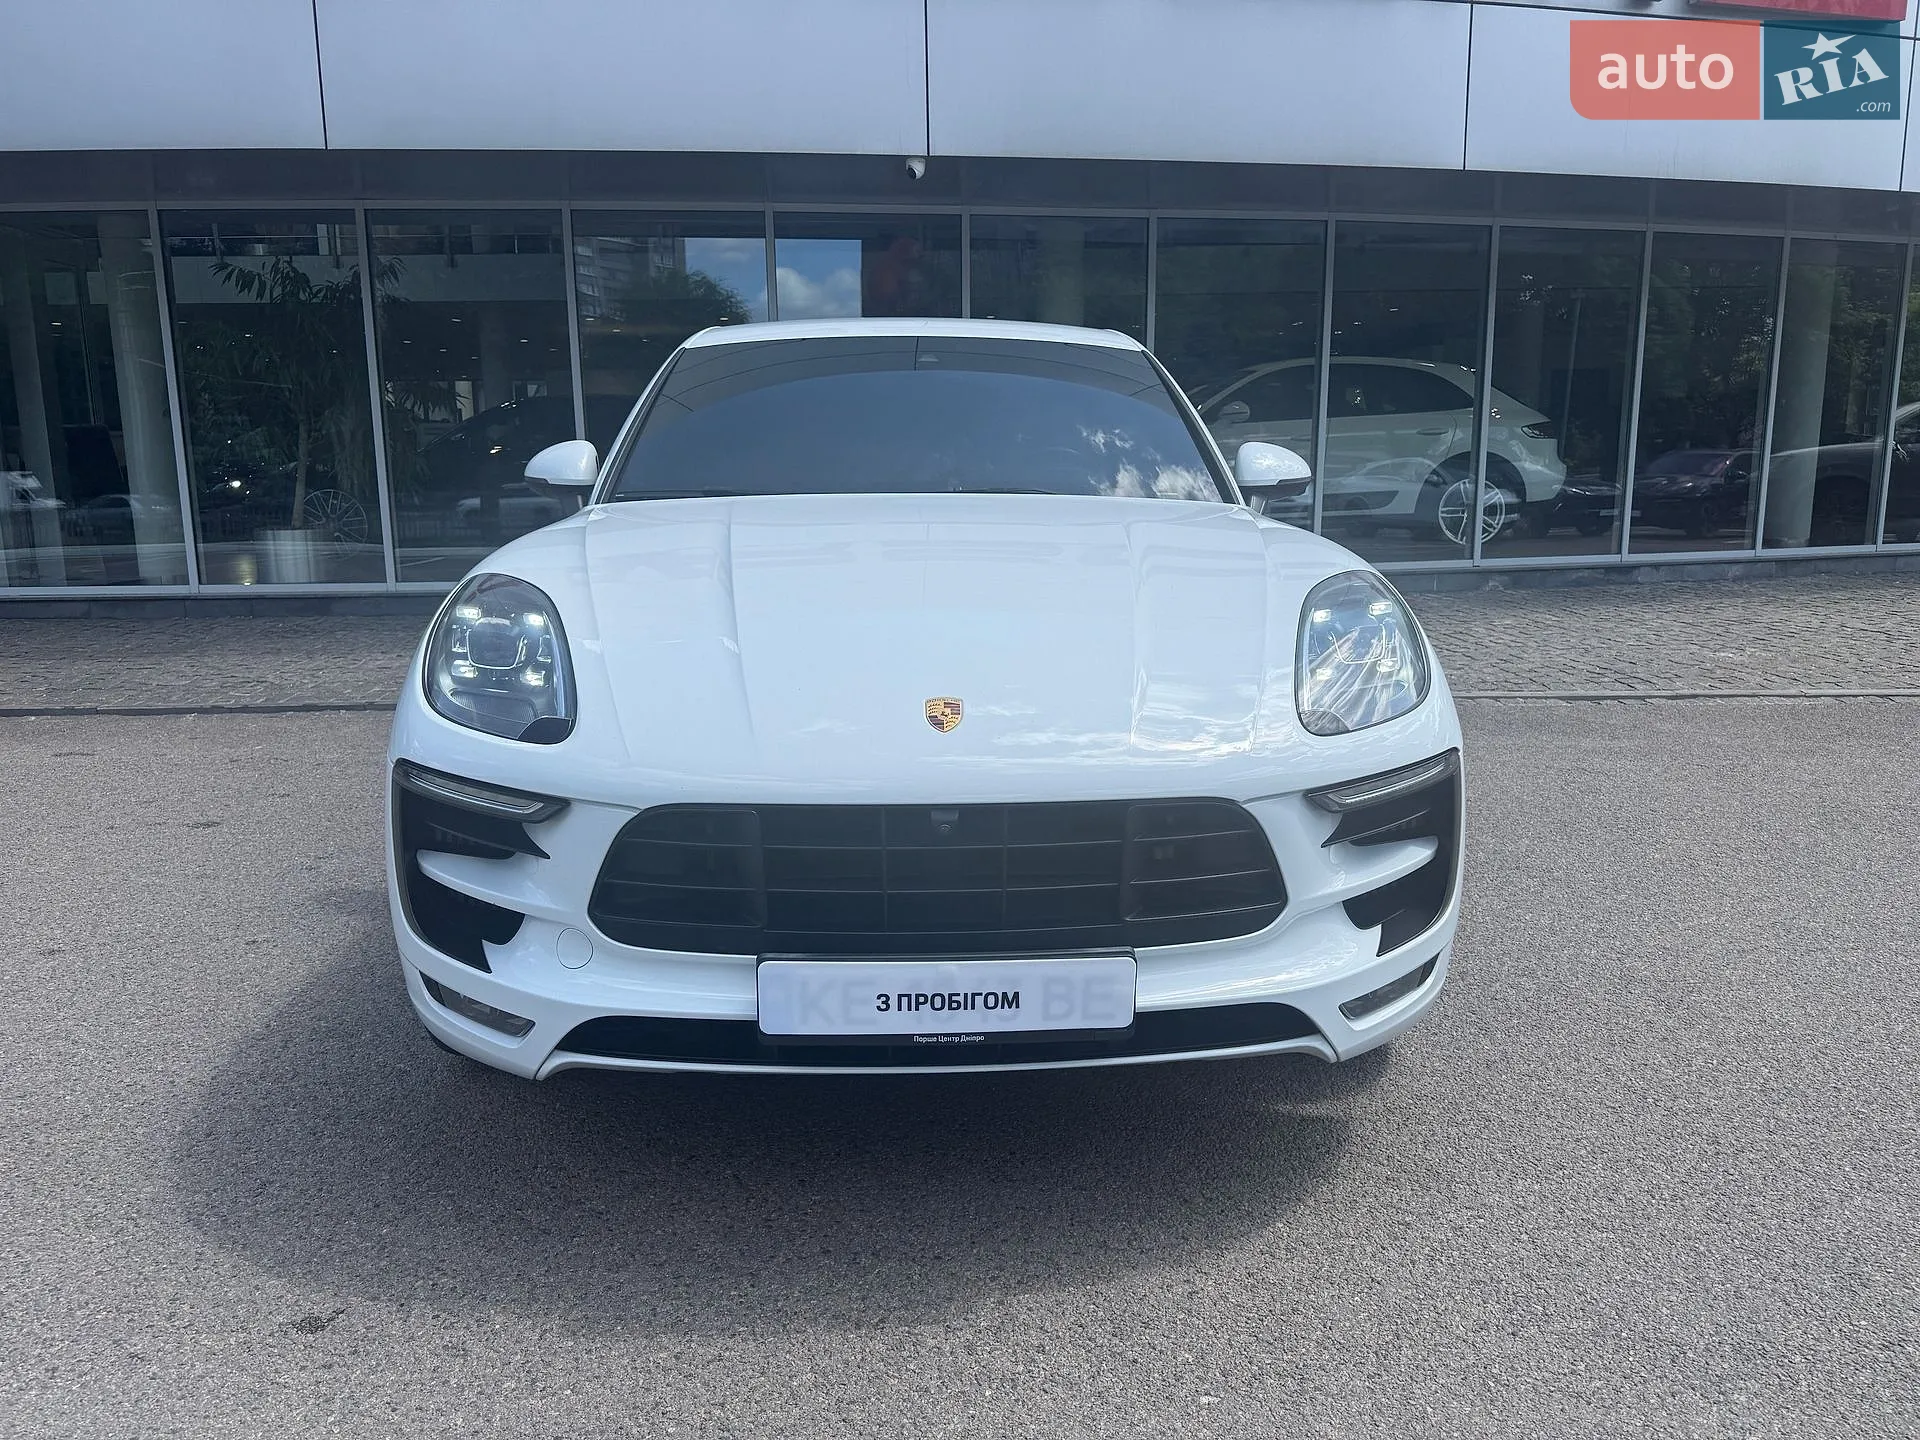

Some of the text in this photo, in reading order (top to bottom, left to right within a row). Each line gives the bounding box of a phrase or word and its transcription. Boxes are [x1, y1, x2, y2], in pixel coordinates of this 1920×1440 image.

[897, 990, 1021, 1012] ПРОБІГОМ
[913, 1035, 938, 1043] Порше
[938, 1035, 960, 1043] Центр
